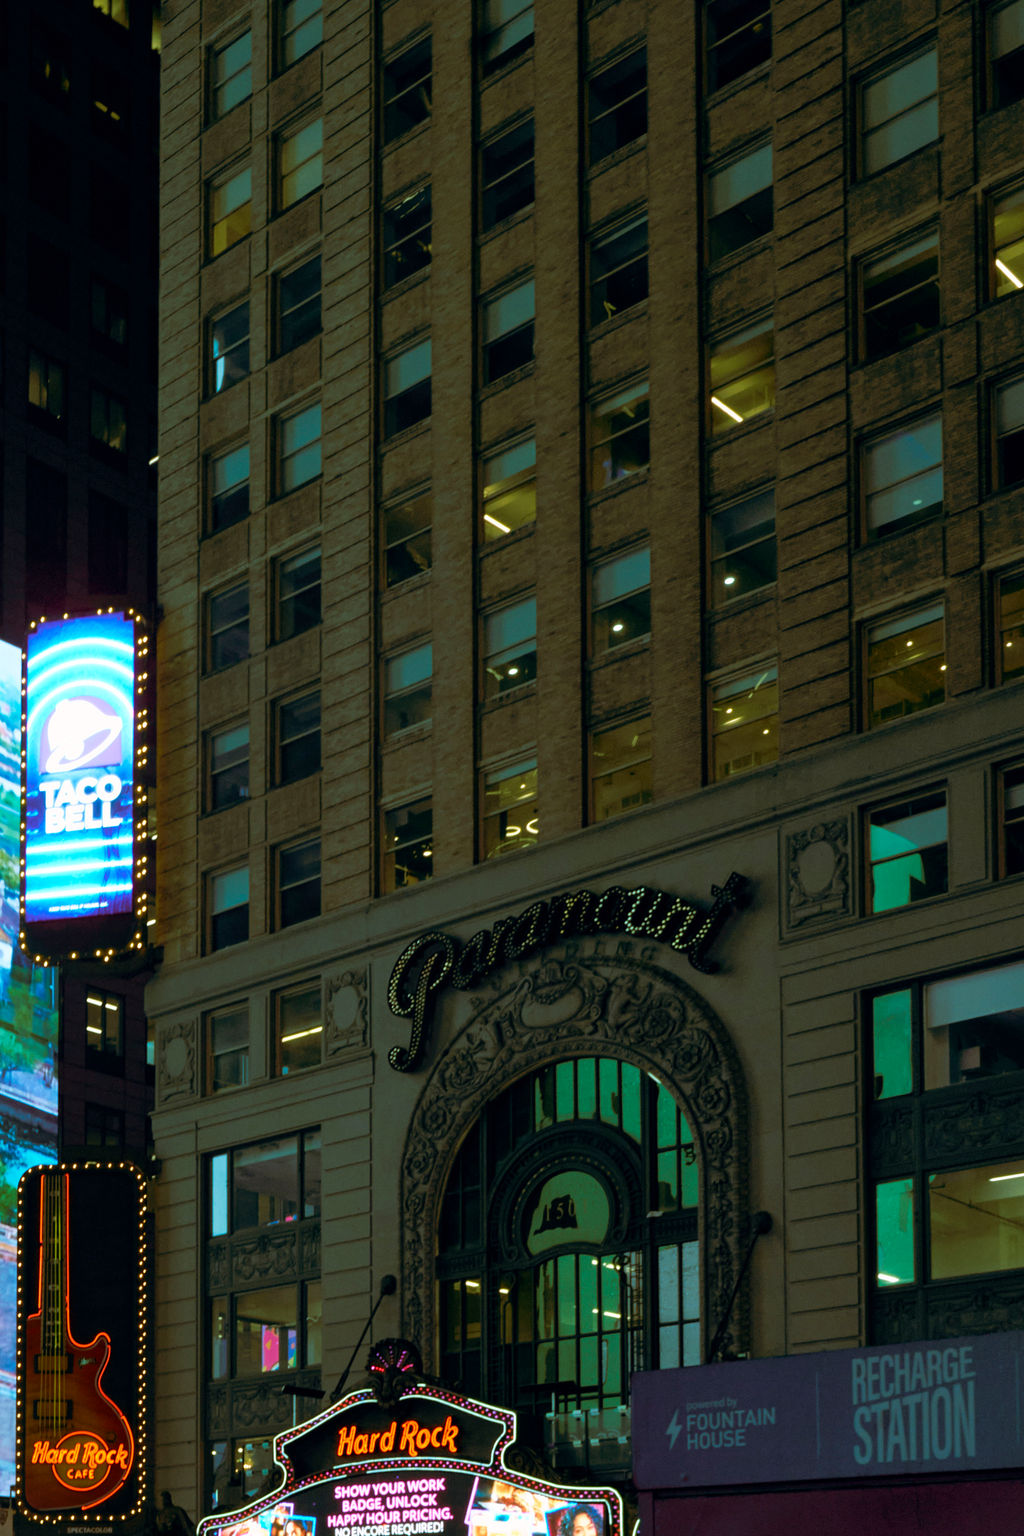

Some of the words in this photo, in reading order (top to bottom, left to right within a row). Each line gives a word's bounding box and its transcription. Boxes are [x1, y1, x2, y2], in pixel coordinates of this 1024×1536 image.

[39, 774, 122, 808] TACO
[45, 802, 123, 834] BELL
[387, 871, 749, 1073] Paramount
[852, 1346, 976, 1405] RECHARGE
[686, 1398, 725, 1412] powered
[726, 1397, 738, 1409] by
[687, 1407, 776, 1430] FOUNTAIN
[853, 1380, 976, 1465] STATION
[337, 1421, 397, 1456] Hard
[400, 1416, 459, 1457] Rock
[687, 1430, 747, 1450] HOUSE
[31, 1441, 81, 1464] Hard
[82, 1441, 128, 1469] Rock
[66, 1468, 95, 1480] CAFE
[334, 1484, 371, 1499] SHOW
[372, 1481, 406, 1496] YOUR
[407, 1478, 446, 1493] WORK
[342, 1497, 385, 1512] BADGE,
[386, 1494, 437, 1509] UNLOCK
[327, 1514, 365, 1528] HAPPY
[366, 1510, 401, 1525] HOUR
[402, 1507, 454, 1522] PRICING.
[391, 1521, 444, 1536] REQUIRED!
[66, 1526, 113, 1535] SPECTACOLOR
